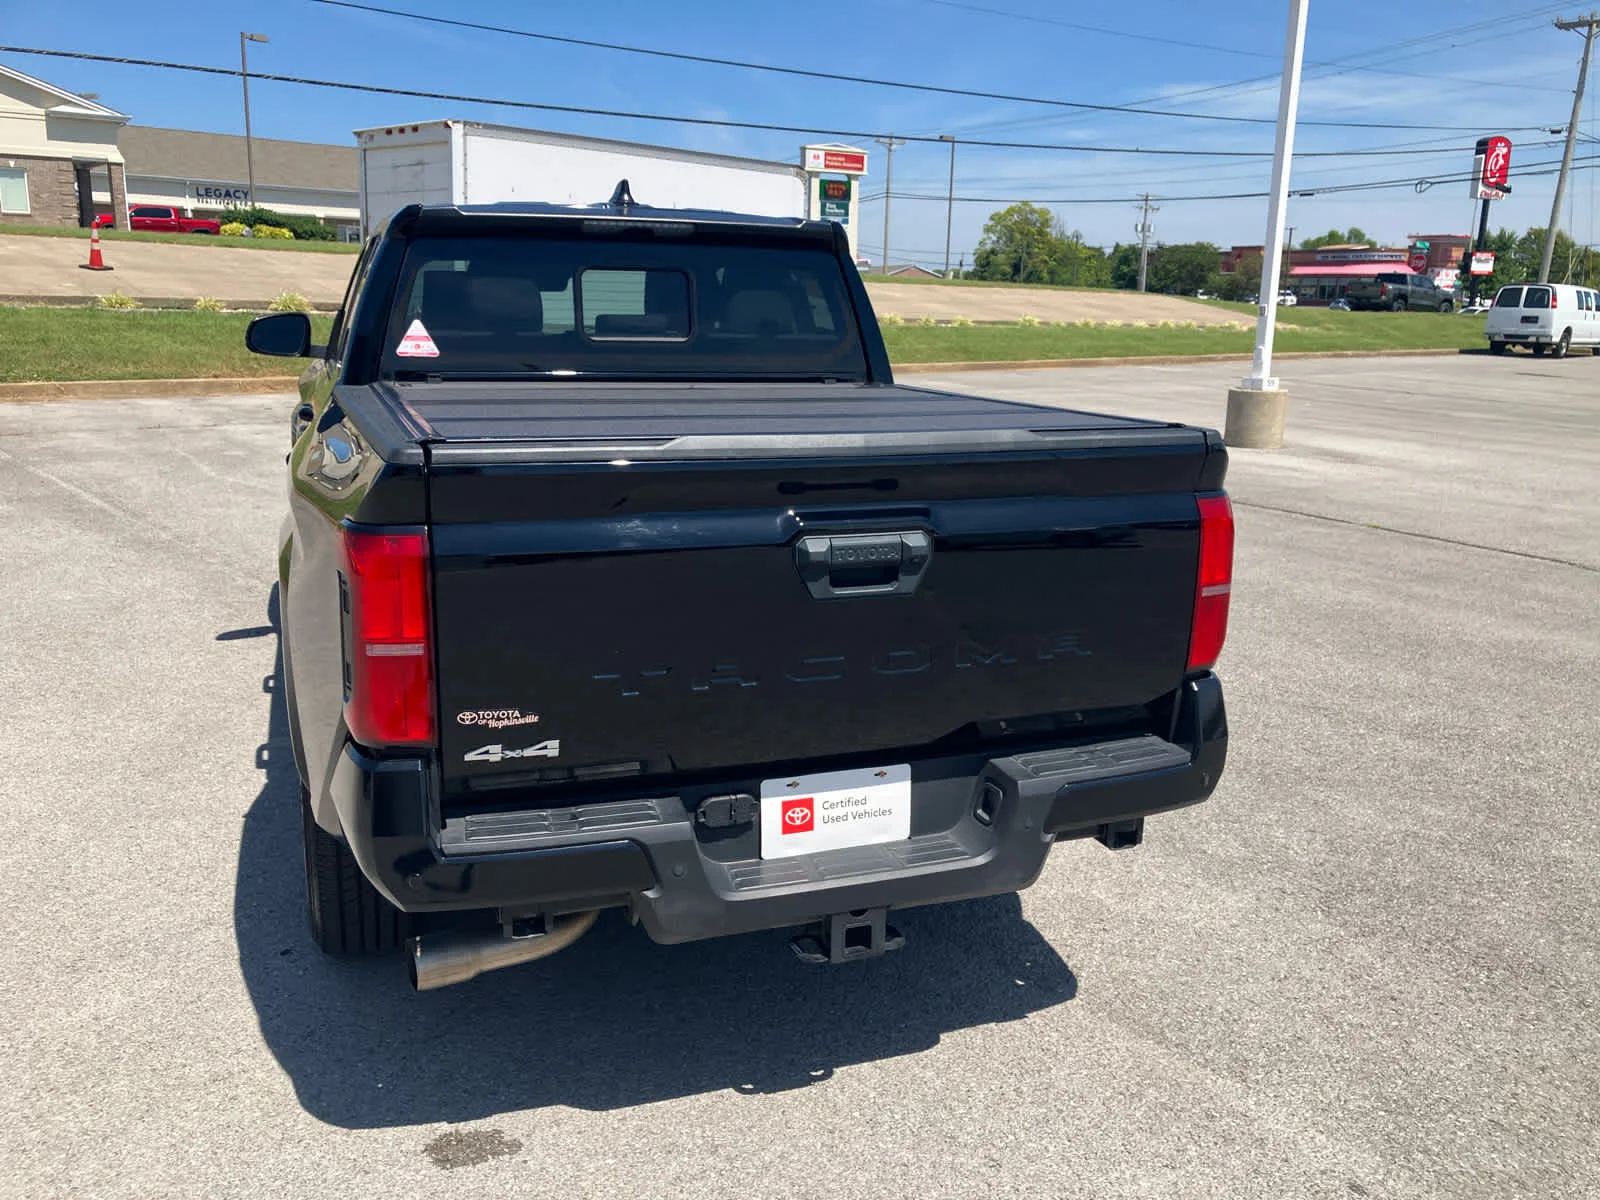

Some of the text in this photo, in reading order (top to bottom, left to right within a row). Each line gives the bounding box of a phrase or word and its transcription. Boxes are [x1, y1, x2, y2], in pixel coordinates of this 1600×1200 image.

[196, 186, 248, 199] LEGACY
[835, 546, 899, 561] TOYOTA
[592, 634, 1093, 696] TACOMA
[478, 710, 520, 719] TOYOTA
[488, 714, 540, 729] Hopkinsville
[822, 796, 867, 810] Certified
[822, 806, 893, 824] Used Vehicles
